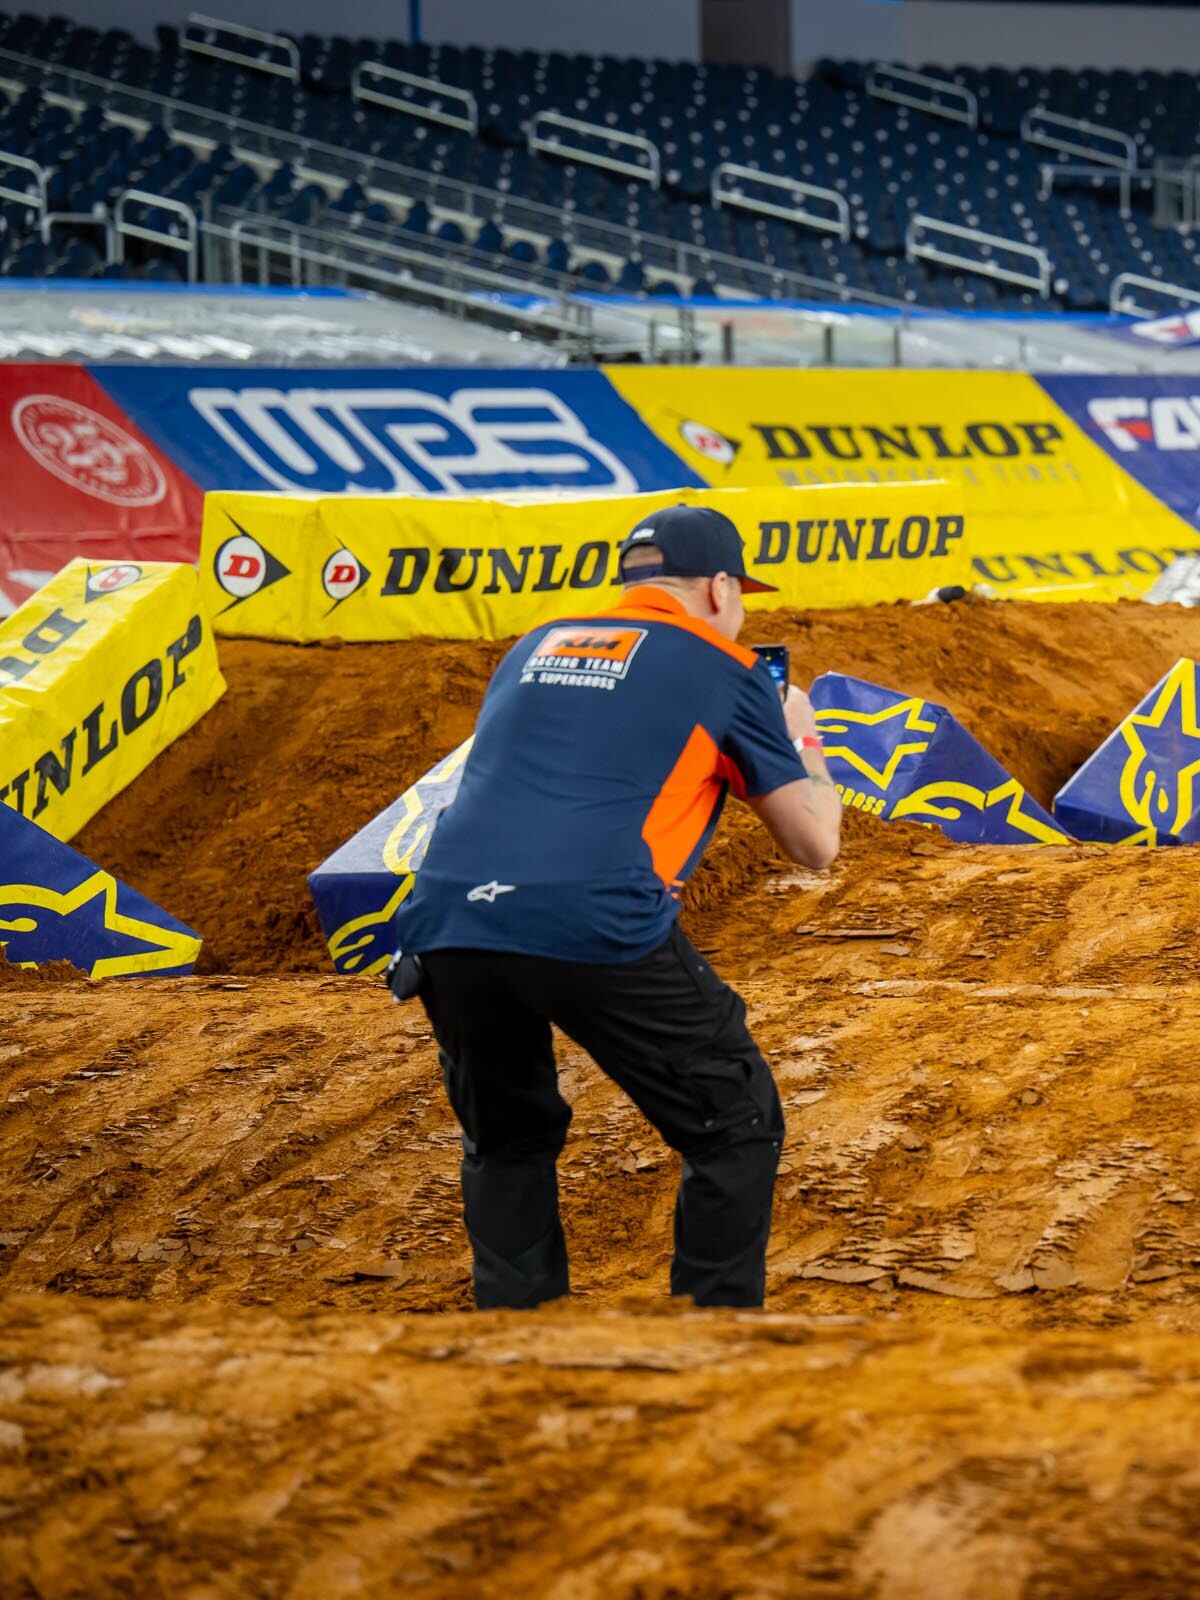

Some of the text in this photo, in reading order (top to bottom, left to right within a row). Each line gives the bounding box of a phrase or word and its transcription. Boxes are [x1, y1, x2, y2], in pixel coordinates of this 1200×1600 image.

[187, 388, 639, 493] WPS
[750, 422, 1063, 460] DUNLOP
[753, 515, 965, 565] DUNLOP
[381, 541, 624, 597] DUNLO
